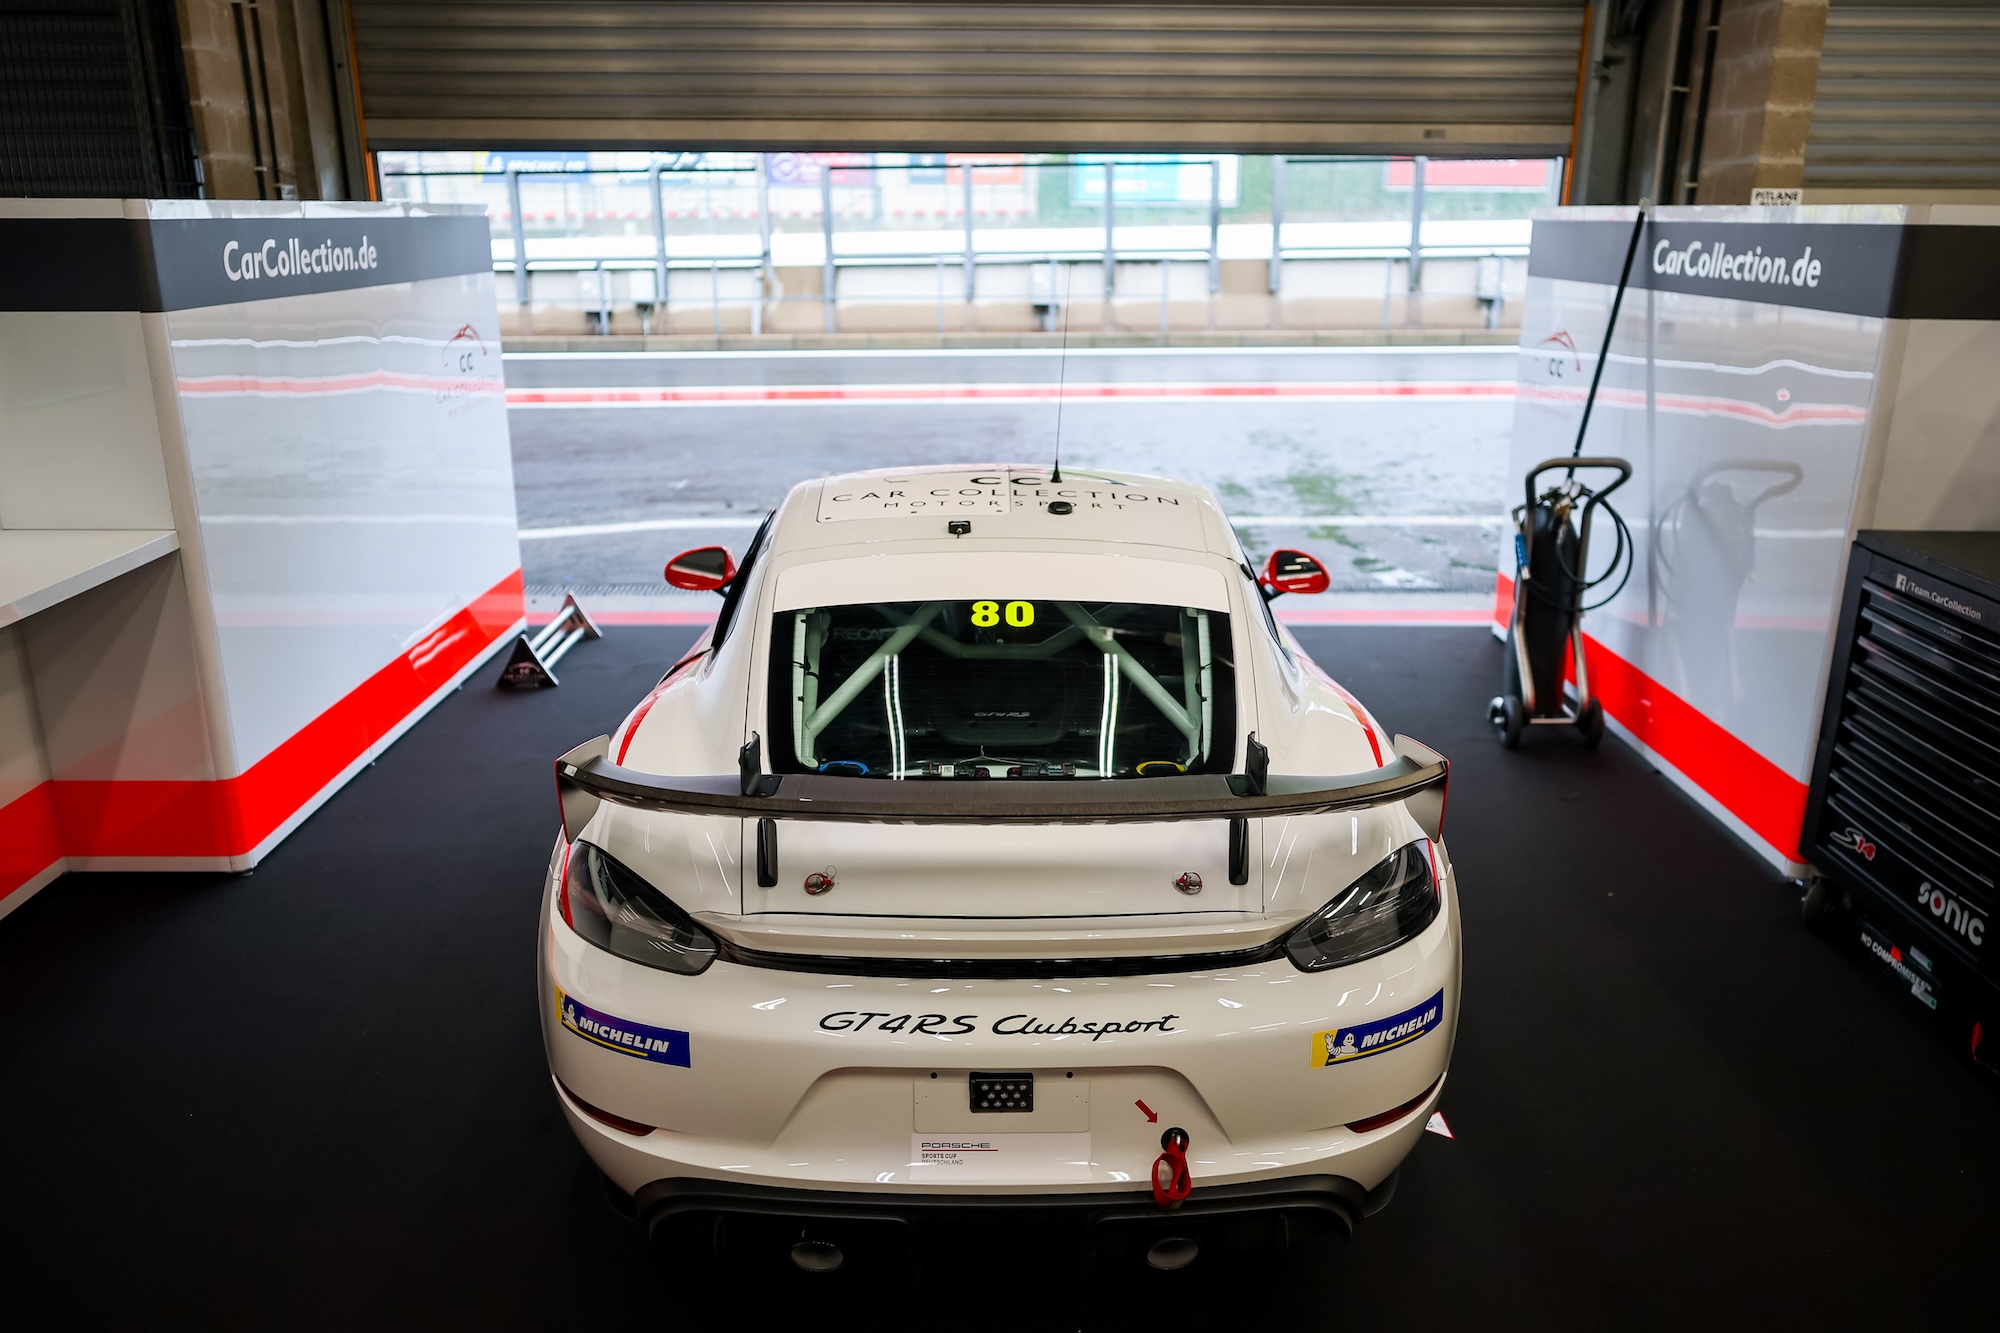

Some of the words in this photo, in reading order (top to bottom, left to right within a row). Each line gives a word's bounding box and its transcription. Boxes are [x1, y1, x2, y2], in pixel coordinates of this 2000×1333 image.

[223, 235, 377, 281] CarCollection.de
[1652, 238, 1822, 288] CarCollection.de
[970, 477, 1042, 486] CC
[832, 491, 906, 502] CAR
[930, 489, 1179, 506] COLLECTION
[971, 601, 1035, 628] 80
[833, 627, 894, 641] RECAR
[579, 1016, 669, 1053] MICHELIN
[818, 1011, 979, 1036] GT4RS
[991, 1014, 1181, 1042] Clubsport
[1361, 1006, 1437, 1048] MICHELIN
